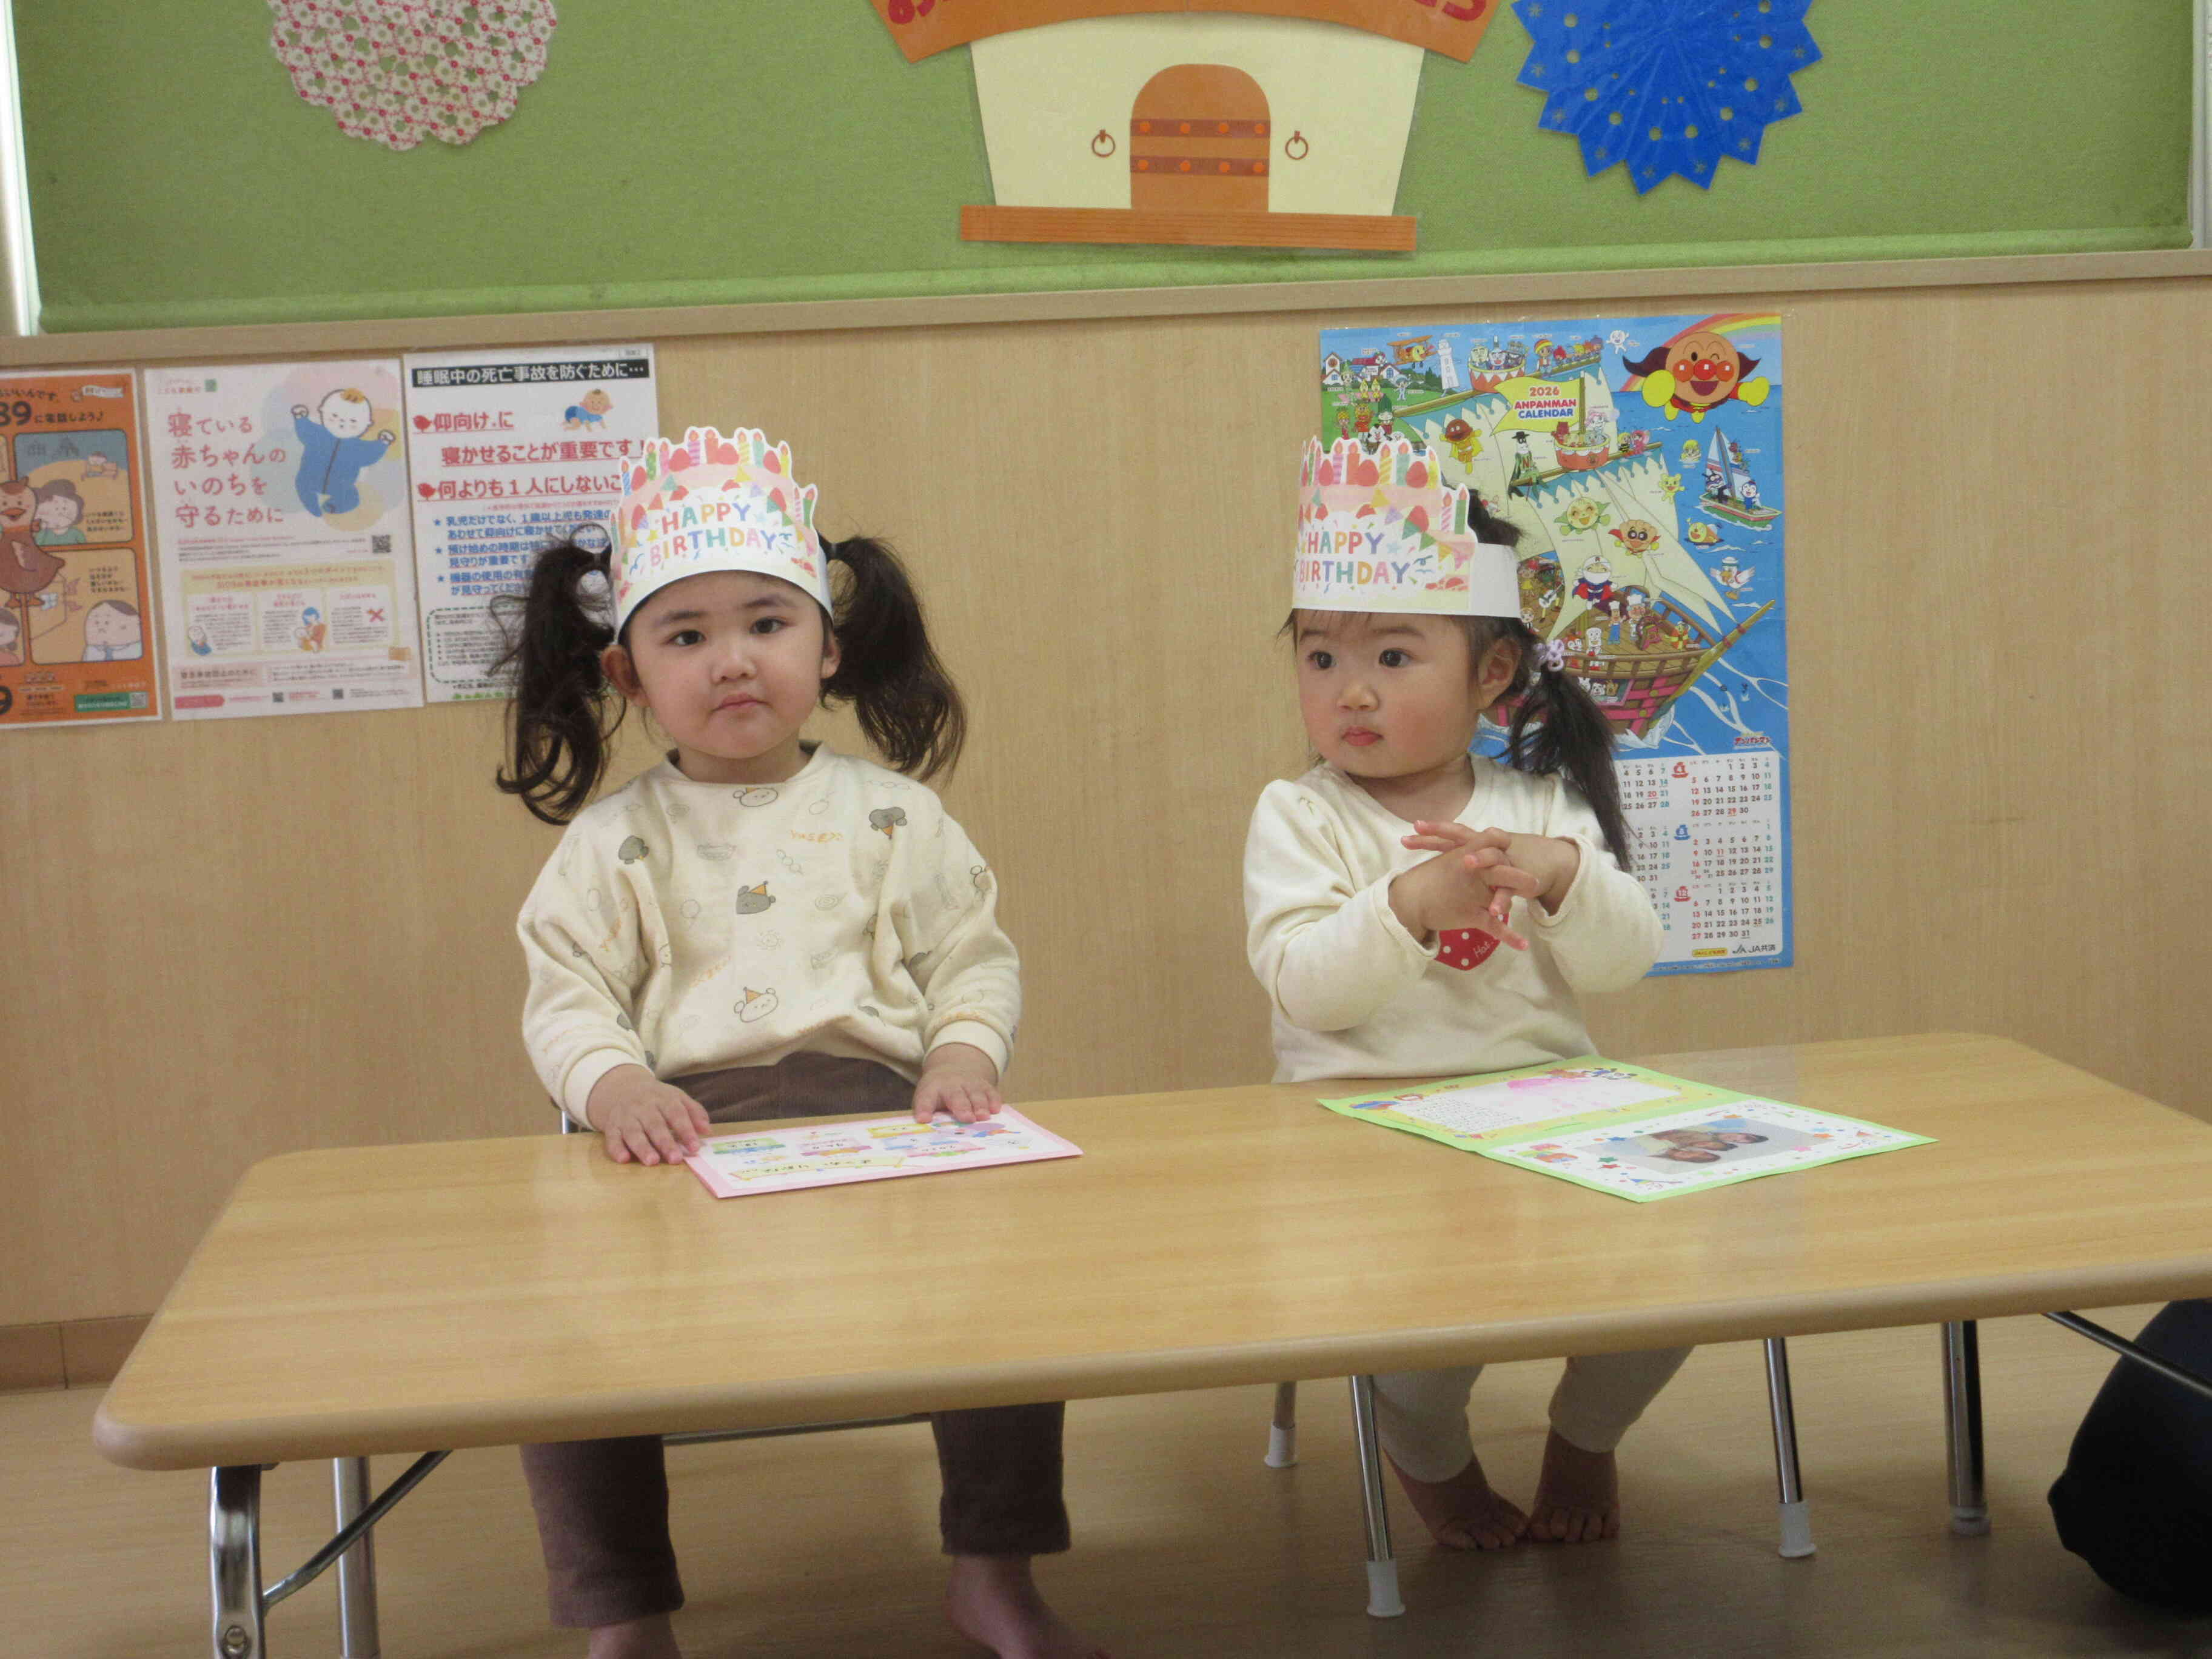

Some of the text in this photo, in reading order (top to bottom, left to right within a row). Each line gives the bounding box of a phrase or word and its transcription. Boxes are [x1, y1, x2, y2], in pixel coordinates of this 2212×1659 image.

[1529, 387, 1560, 397] 2026
[1514, 399, 1577, 410] ANPANMAN
[1518, 409, 1574, 419] CALENDAR
[168, 413, 253, 437] 寝ている
[172, 443, 286, 469] 赤ちゃんの
[174, 474, 267, 496] いのちを
[175, 504, 284, 528] 守るために
[662, 503, 751, 534] HAPPY
[650, 527, 777, 567] BIRTHDAY
[1307, 531, 1385, 555] HAPPY
[1299, 560, 1411, 585] BIRTHDAY
